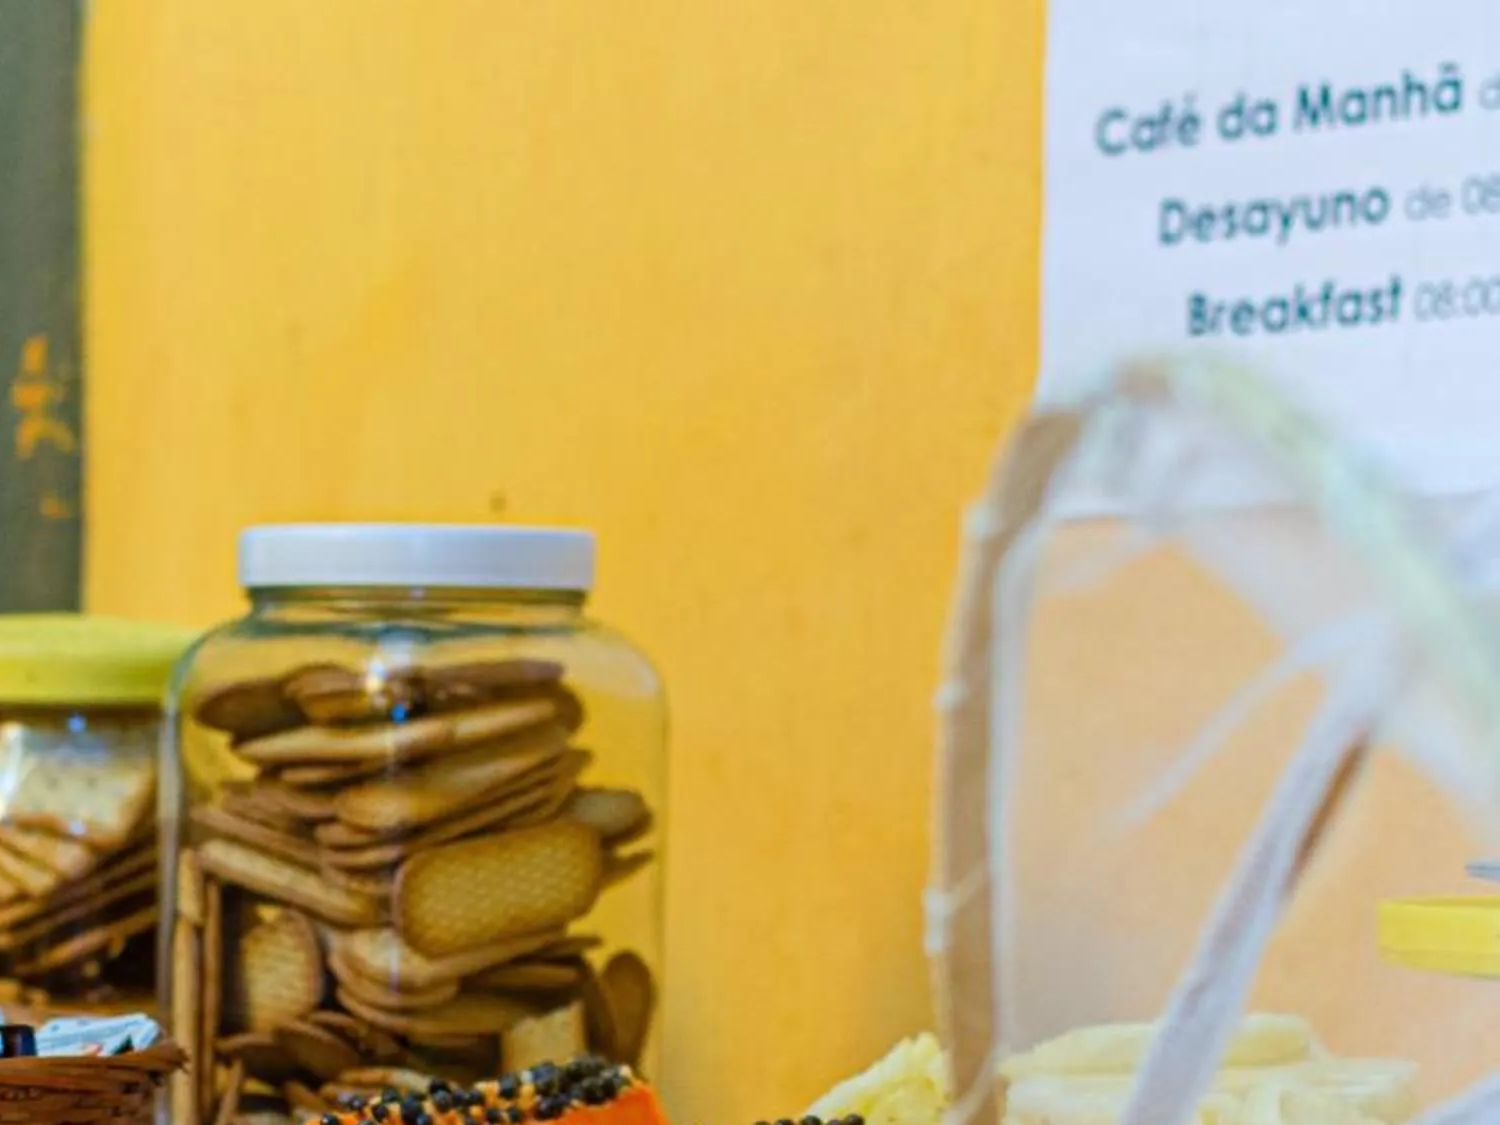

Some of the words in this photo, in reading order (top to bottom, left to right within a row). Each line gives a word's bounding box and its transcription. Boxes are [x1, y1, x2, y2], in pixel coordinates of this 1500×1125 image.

[1096, 96, 1201, 155] Café
[1217, 93, 1278, 140] da
[1296, 63, 1463, 130] Manhã
[1160, 187, 1390, 246] Desayuno
[1188, 276, 1402, 337] Breakfast
